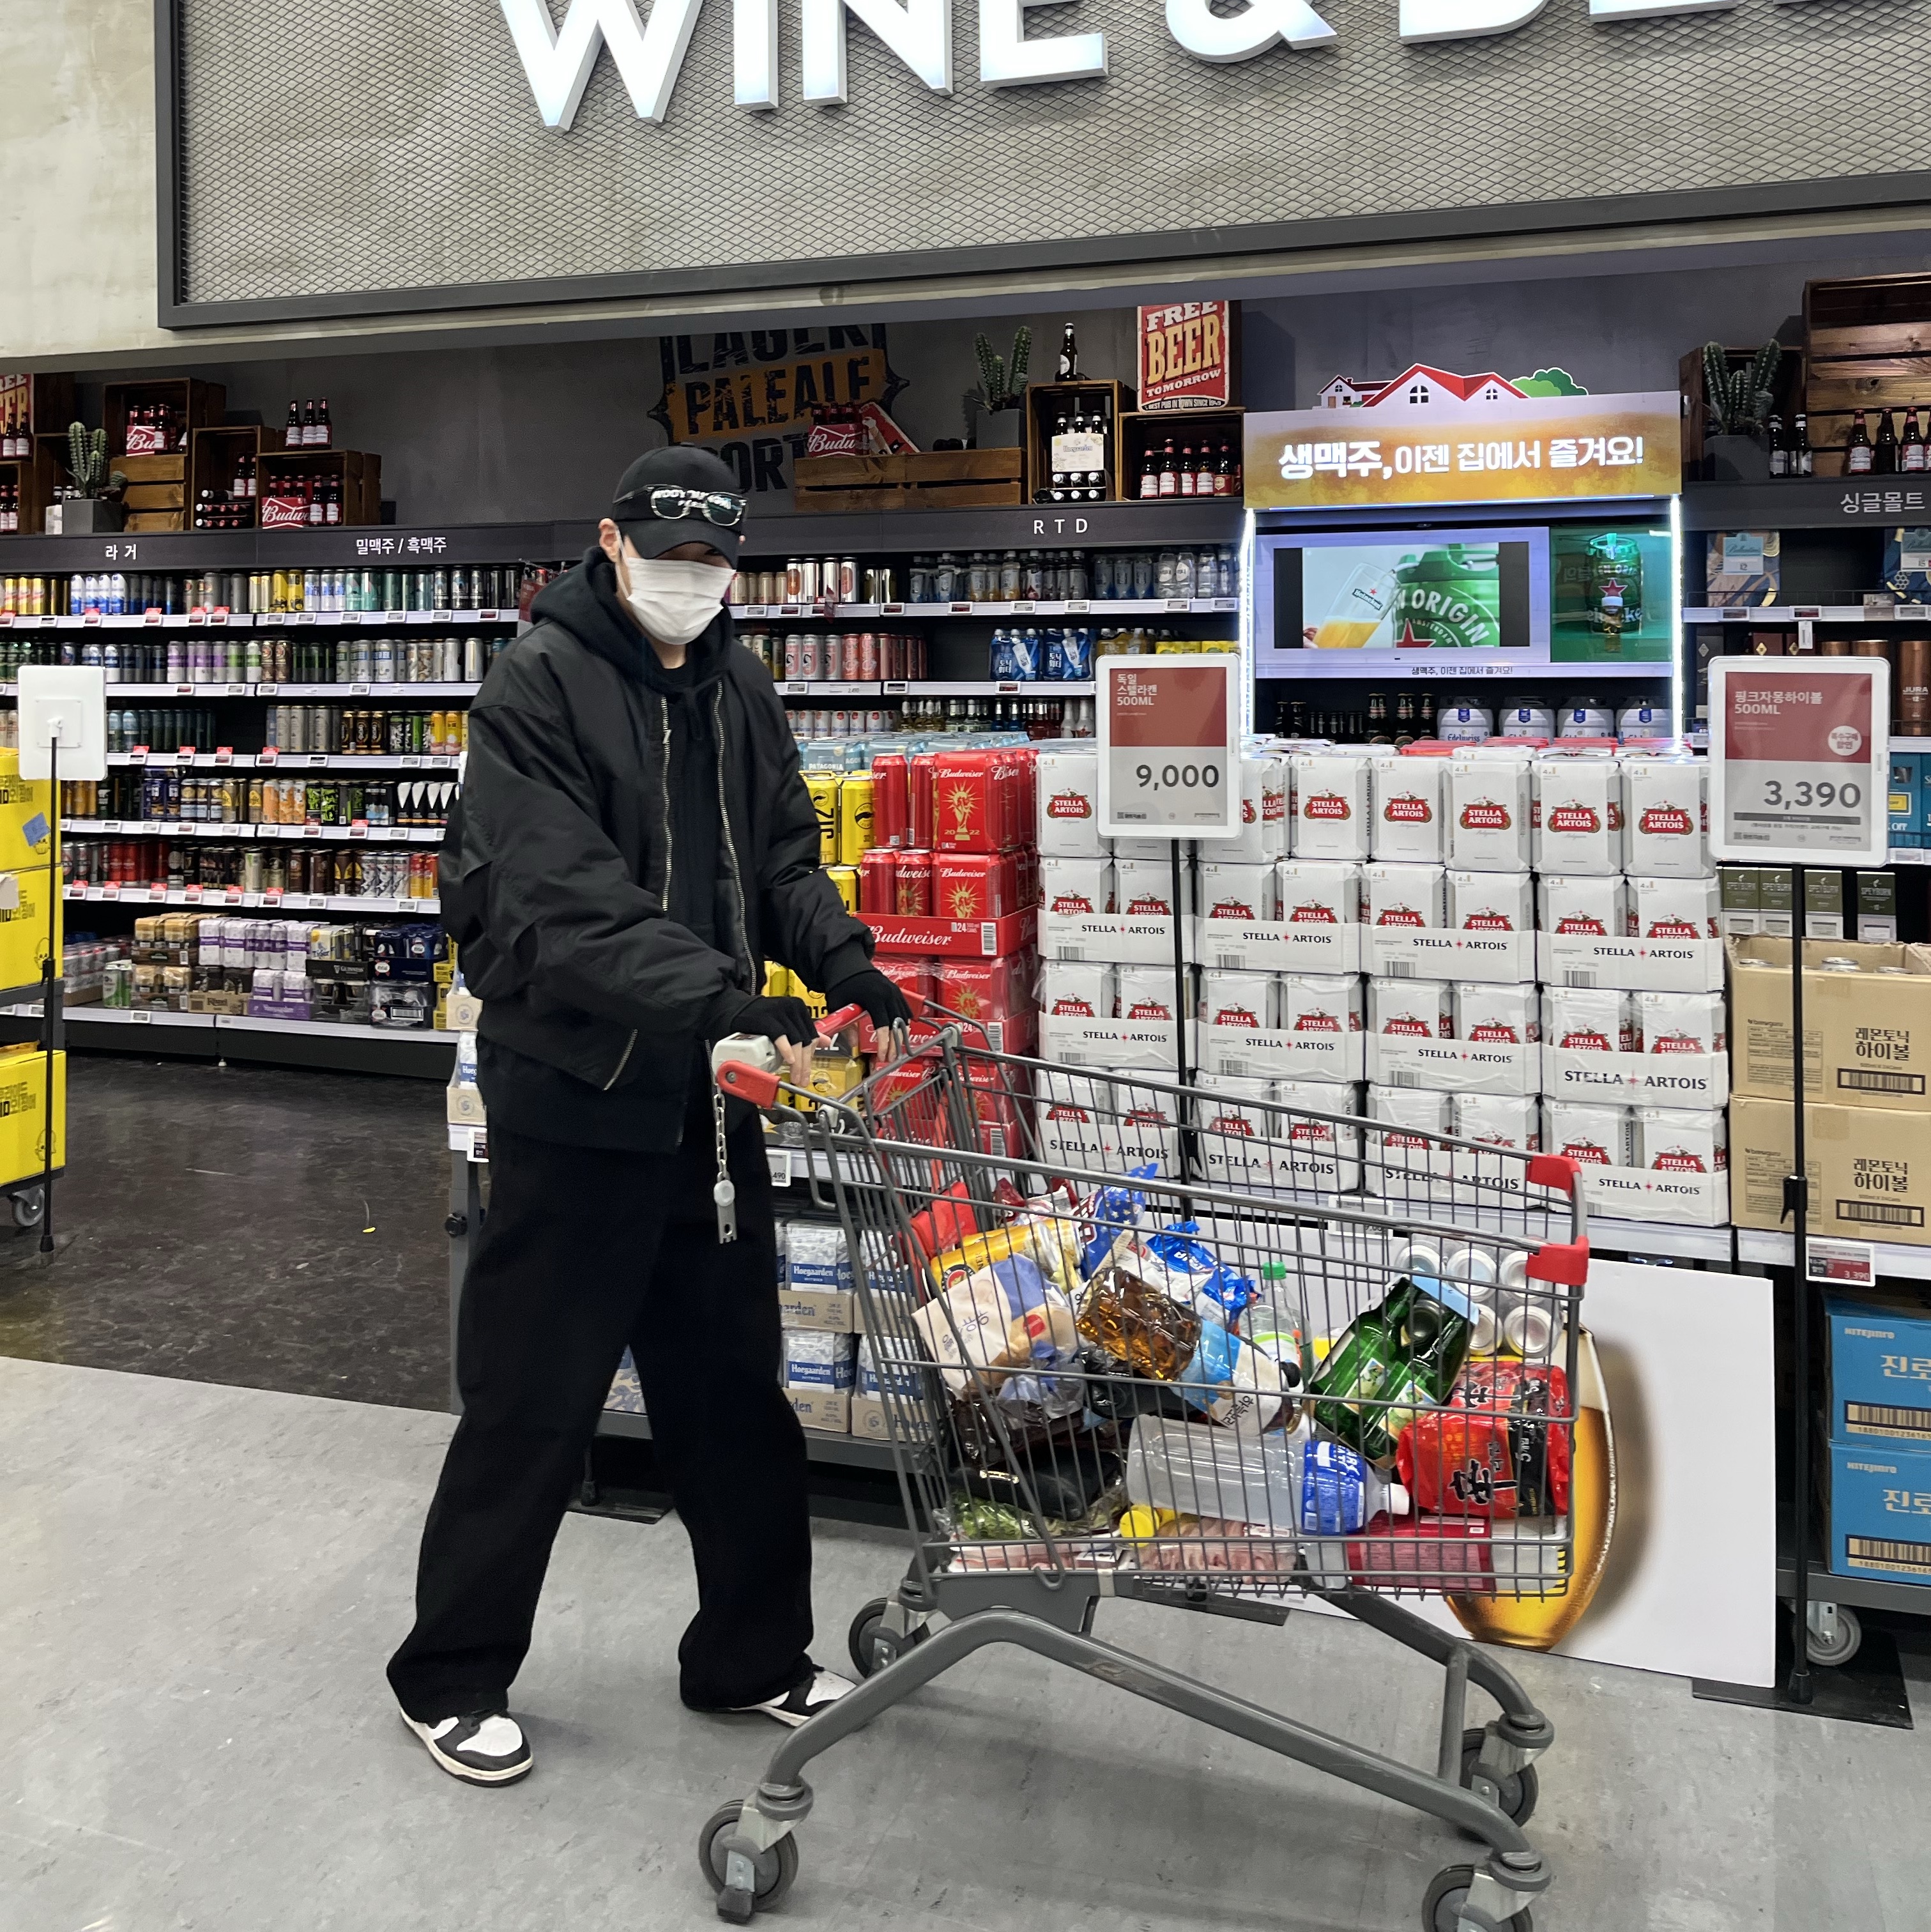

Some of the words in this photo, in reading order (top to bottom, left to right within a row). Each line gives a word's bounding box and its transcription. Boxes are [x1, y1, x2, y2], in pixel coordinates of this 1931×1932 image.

[1147, 314, 1221, 385] BEER
[1146, 369, 1221, 397] TOMORROW
[1457, 440, 1541, 471] 집에서
[1548, 436, 1644, 466] 즐겨요!
[1840, 492, 1926, 514] 싱글몰트
[356, 538, 395, 555] 밀맥주
[407, 537, 447, 554] 흑맥주
[1117, 673, 1137, 685] 독일
[1117, 684, 1157, 696] 스텔라캔
[1117, 697, 1154, 705] 500ML
[1735, 691, 1823, 705] 핑크자몽하이볼
[1734, 704, 1781, 715] 500ML
[939, 768, 984, 778] Budweiser
[1136, 765, 1219, 791] 9,000
[1764, 780, 1861, 810] 3,390
[940, 868, 986, 878] Budweiser
[1384, 914, 1417, 923] STELLA
[957, 923, 967, 932] 24
[1081, 924, 1117, 933] STELLA
[1128, 926, 1165, 935] ARTOIS
[1564, 923, 1598, 931] STELLA
[869, 925, 952, 946] Budweiser
[1242, 932, 1279, 941] STELLA
[1292, 935, 1332, 944] ARTOIS
[1413, 939, 1453, 947] STELLA
[1465, 941, 1507, 950] ARTOIS
[1593, 947, 1635, 957] STELLA
[1649, 949, 1693, 958] ARTOIS
[943, 969, 991, 980] Budweiser
[1221, 1015, 1251, 1023] STELLA
[1391, 1023, 1423, 1032] STELLA
[1083, 1031, 1118, 1039] STELLA
[1130, 1034, 1167, 1042] ARTOIS
[1568, 1037, 1603, 1045] STELLA
[1855, 1027, 1910, 1043] 레몬토닉
[1246, 1039, 1283, 1048] STELLA
[1295, 1041, 1334, 1050] ARTOIS
[1660, 1041, 1695, 1050] STELLA
[1418, 1049, 1457, 1059] STELLA
[1471, 1054, 1512, 1063] ARTOIS
[1855, 1041, 1910, 1061] 하이볼
[1565, 1071, 1624, 1085] STELLA
[1644, 1076, 1707, 1090] ARTOIS
[1391, 1135, 1424, 1144] STELLA
[1568, 1149, 1602, 1158] STELLA
[1209, 1154, 1261, 1168] STELLA
[1279, 1160, 1336, 1174] ARTOIS
[1661, 1158, 1697, 1167] STELLA
[1852, 1158, 1909, 1176] 레몬토닉
[1599, 1178, 1640, 1190] STELLA
[1655, 1184, 1702, 1195] ARTOIS
[1852, 1172, 1909, 1193] 하이볼
[793, 1266, 833, 1277] Hoegaarden
[791, 1363, 830, 1376] Hoegaarden
[1221, 1395, 1255, 1426] 하늘보리
